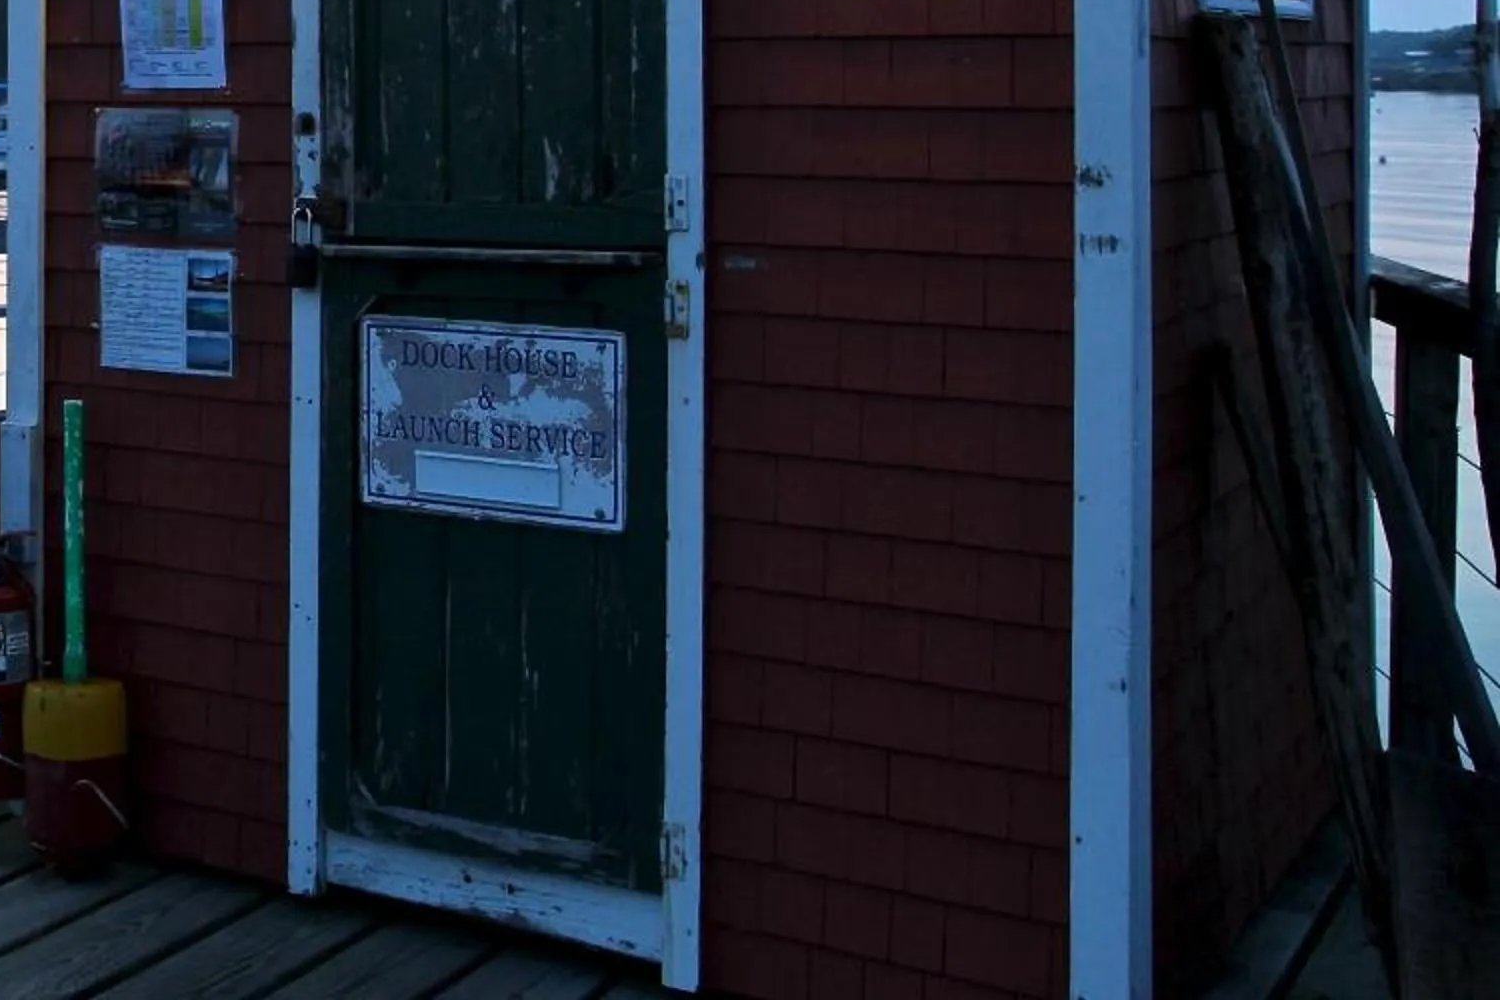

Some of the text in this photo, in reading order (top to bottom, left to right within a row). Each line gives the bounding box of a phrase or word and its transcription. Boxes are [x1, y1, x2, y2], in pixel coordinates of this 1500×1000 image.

[401, 340, 578, 378] DOCK HOUSE
[478, 383, 496, 410] &
[375, 411, 606, 459] LAUNCH SERVICE
